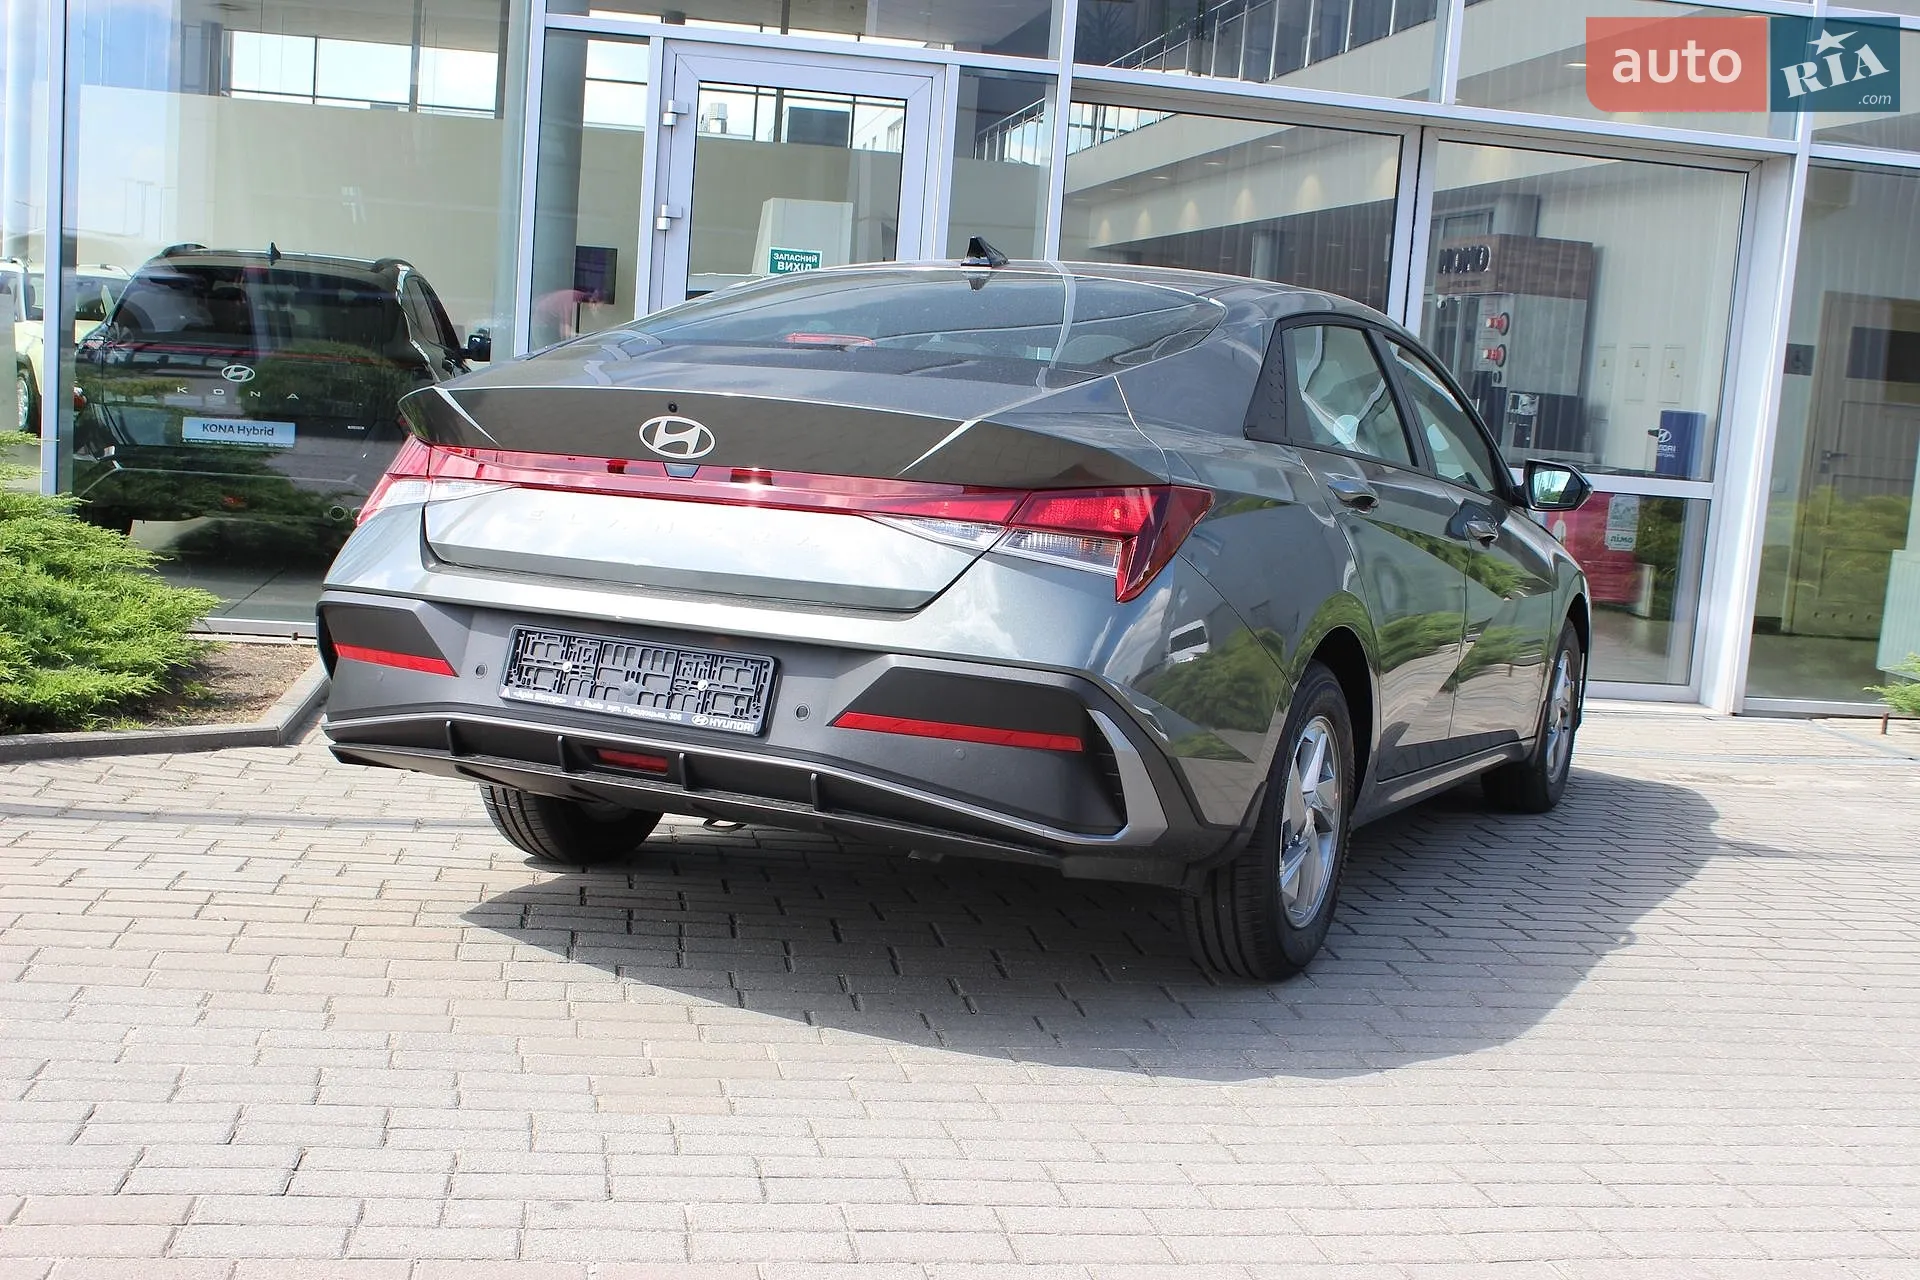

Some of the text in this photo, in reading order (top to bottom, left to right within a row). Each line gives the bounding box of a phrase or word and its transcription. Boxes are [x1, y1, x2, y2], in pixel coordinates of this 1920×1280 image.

[773, 253, 818, 263] ЗАПАСНИЙ
[777, 262, 812, 271] ВИХІД
[176, 386, 299, 400] KONA
[202, 423, 274, 437] KONA Hybrid
[709, 717, 755, 733] HYUNDAI
